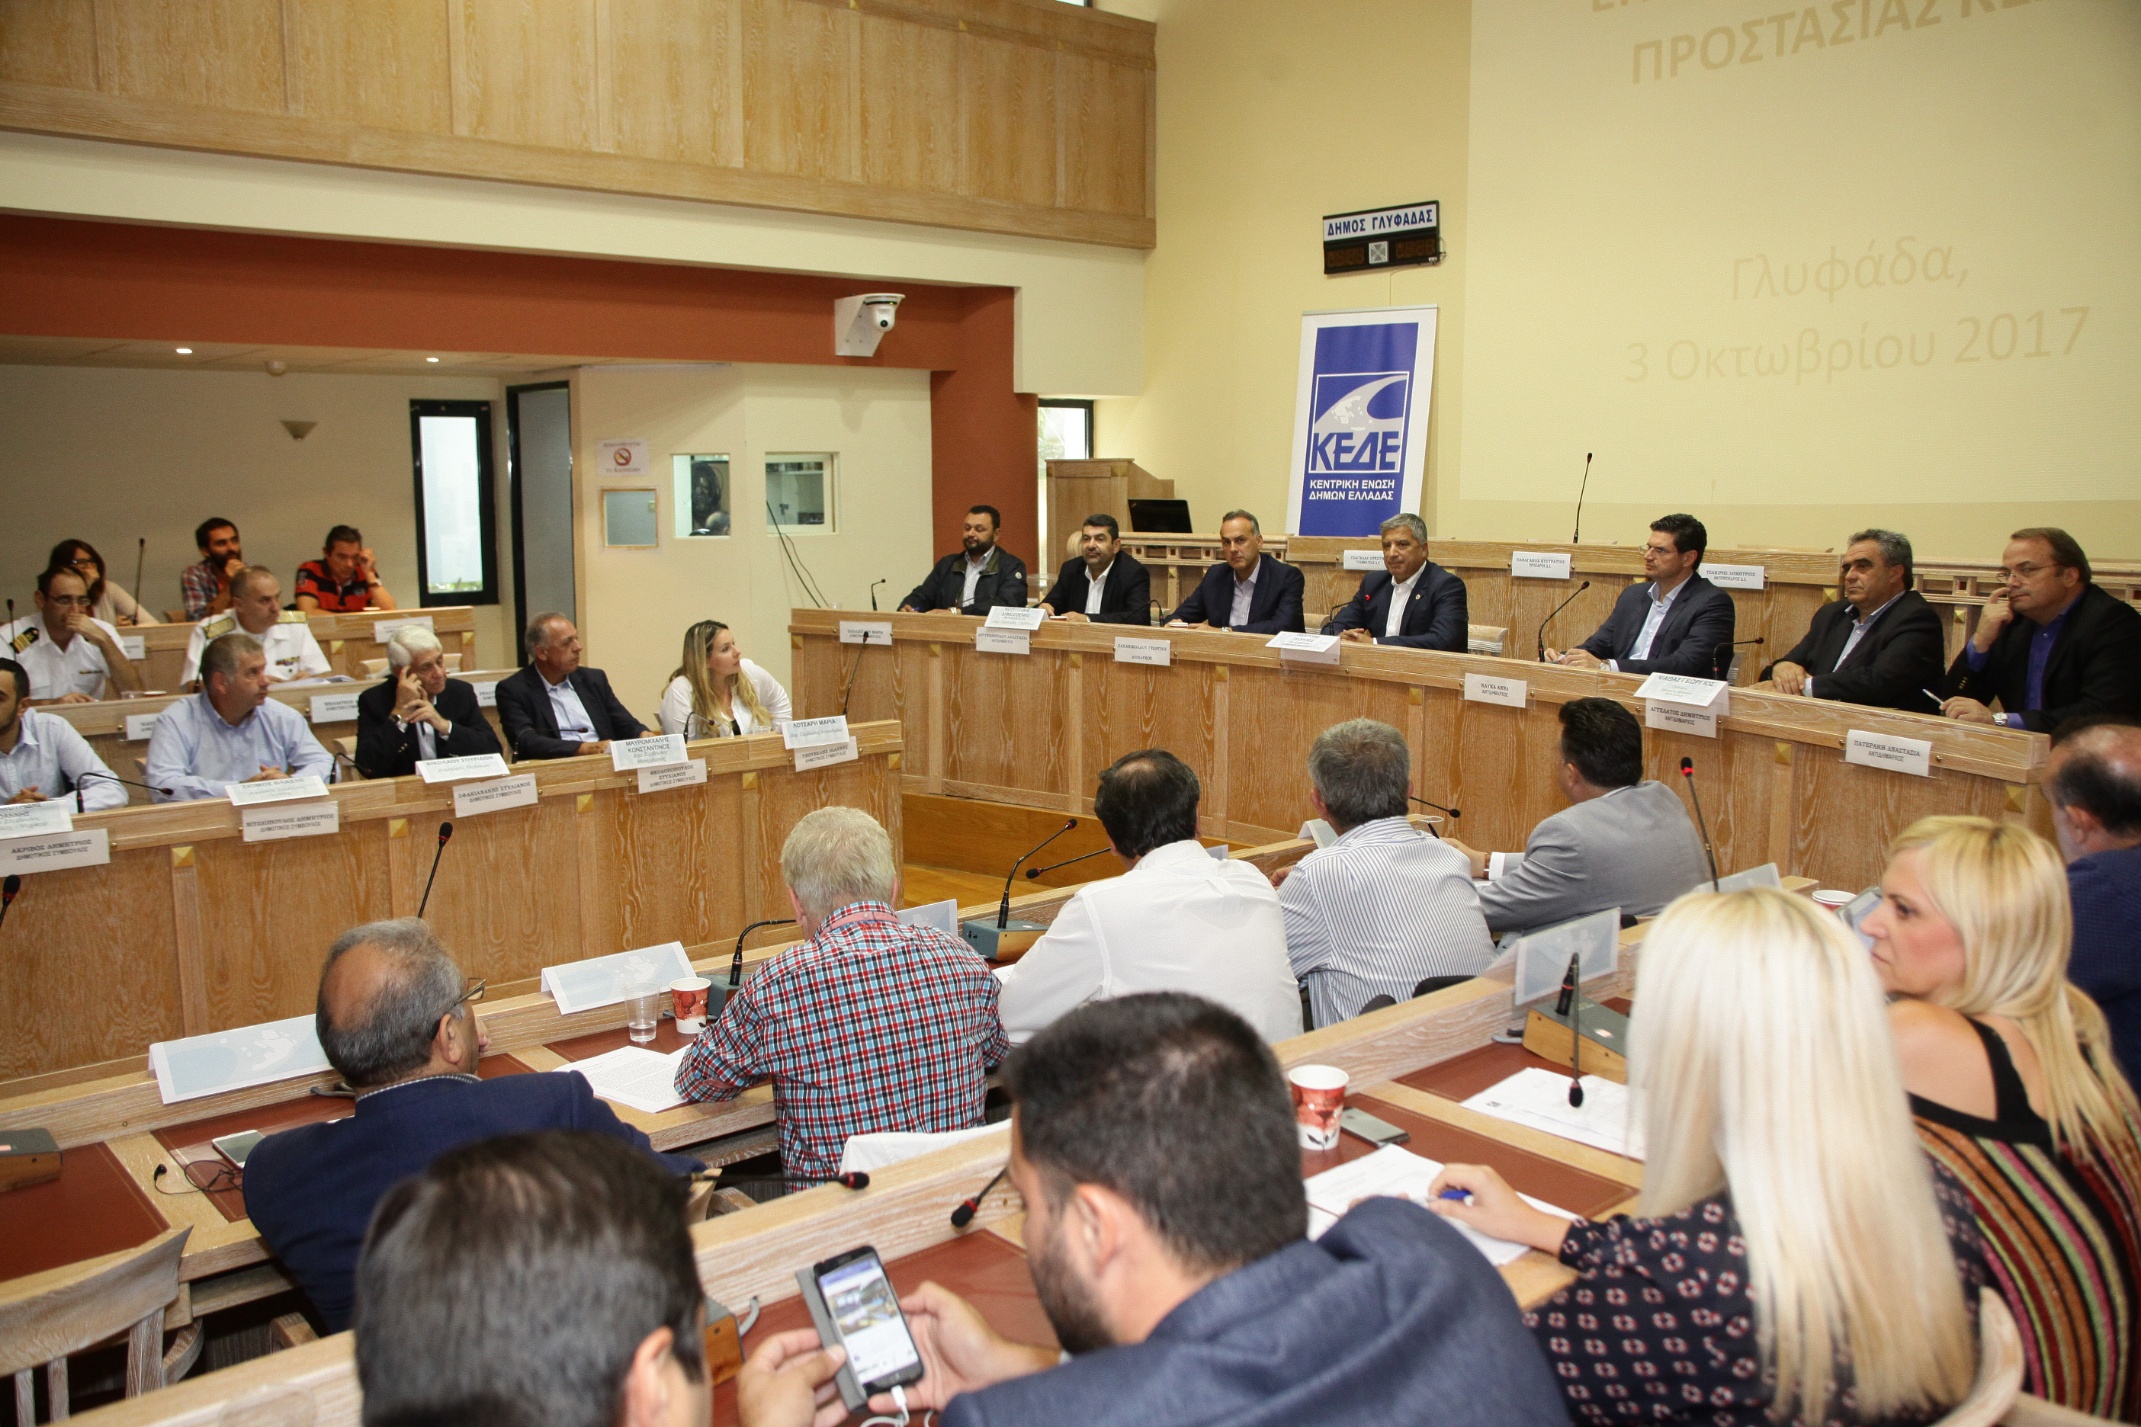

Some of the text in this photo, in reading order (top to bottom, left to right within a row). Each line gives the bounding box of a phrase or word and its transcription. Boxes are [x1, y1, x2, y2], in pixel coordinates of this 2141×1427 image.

[1327, 209, 1433, 236] ΔΗΜΟΣ ΓΛΥΦΑΔΑΣ
[1731, 235, 1970, 303] Γλυφάδα,
[1625, 306, 2091, 386] 3 Οκτωβρίου 2017
[1310, 431, 1401, 471] ΚΕΔΕ
[1309, 479, 1395, 489] ΚΕΝΤΡΙΚΗ ΕΝΩΣΗ
[1308, 491, 1394, 500] ΔΗΜΩΝ ΕΛΛΑΔΑΣ
[1680, 712, 1711, 721] ΔΗΜΗΤΡΙΟΣ
[625, 736, 670, 746] ΜΑΥΡΟΜΙΧΑΛΗΣ
[628, 744, 670, 753] ΚΩΝΣΤΑΝΤΙΝΟΣ
[1853, 740, 1921, 757] ΠΑΤΕΡΑΚΗ ΑΝΑΣΤΑΣΙΑ
[1868, 751, 1904, 762] ΑΝΤΙΔΗΜΑΡΧΟΣ
[649, 775, 696, 787] ΔΗΜΟΤΙΚΟΣ ΣΥΜΒΟΥΛΟΣ
[659, 771, 686, 780] ΣΤΥΛΙΑΝΟΣ
[500, 781, 532, 791] ΣΤΥΛΙΑΝΟΣ
[47, 839, 92, 850] ΔΗΜΗΤΡΙΟΣ
[16, 846, 89, 861] ΔΗΜΟΤΙΚΟΣ ΣΥΜΒΟΥΛΟΣ
